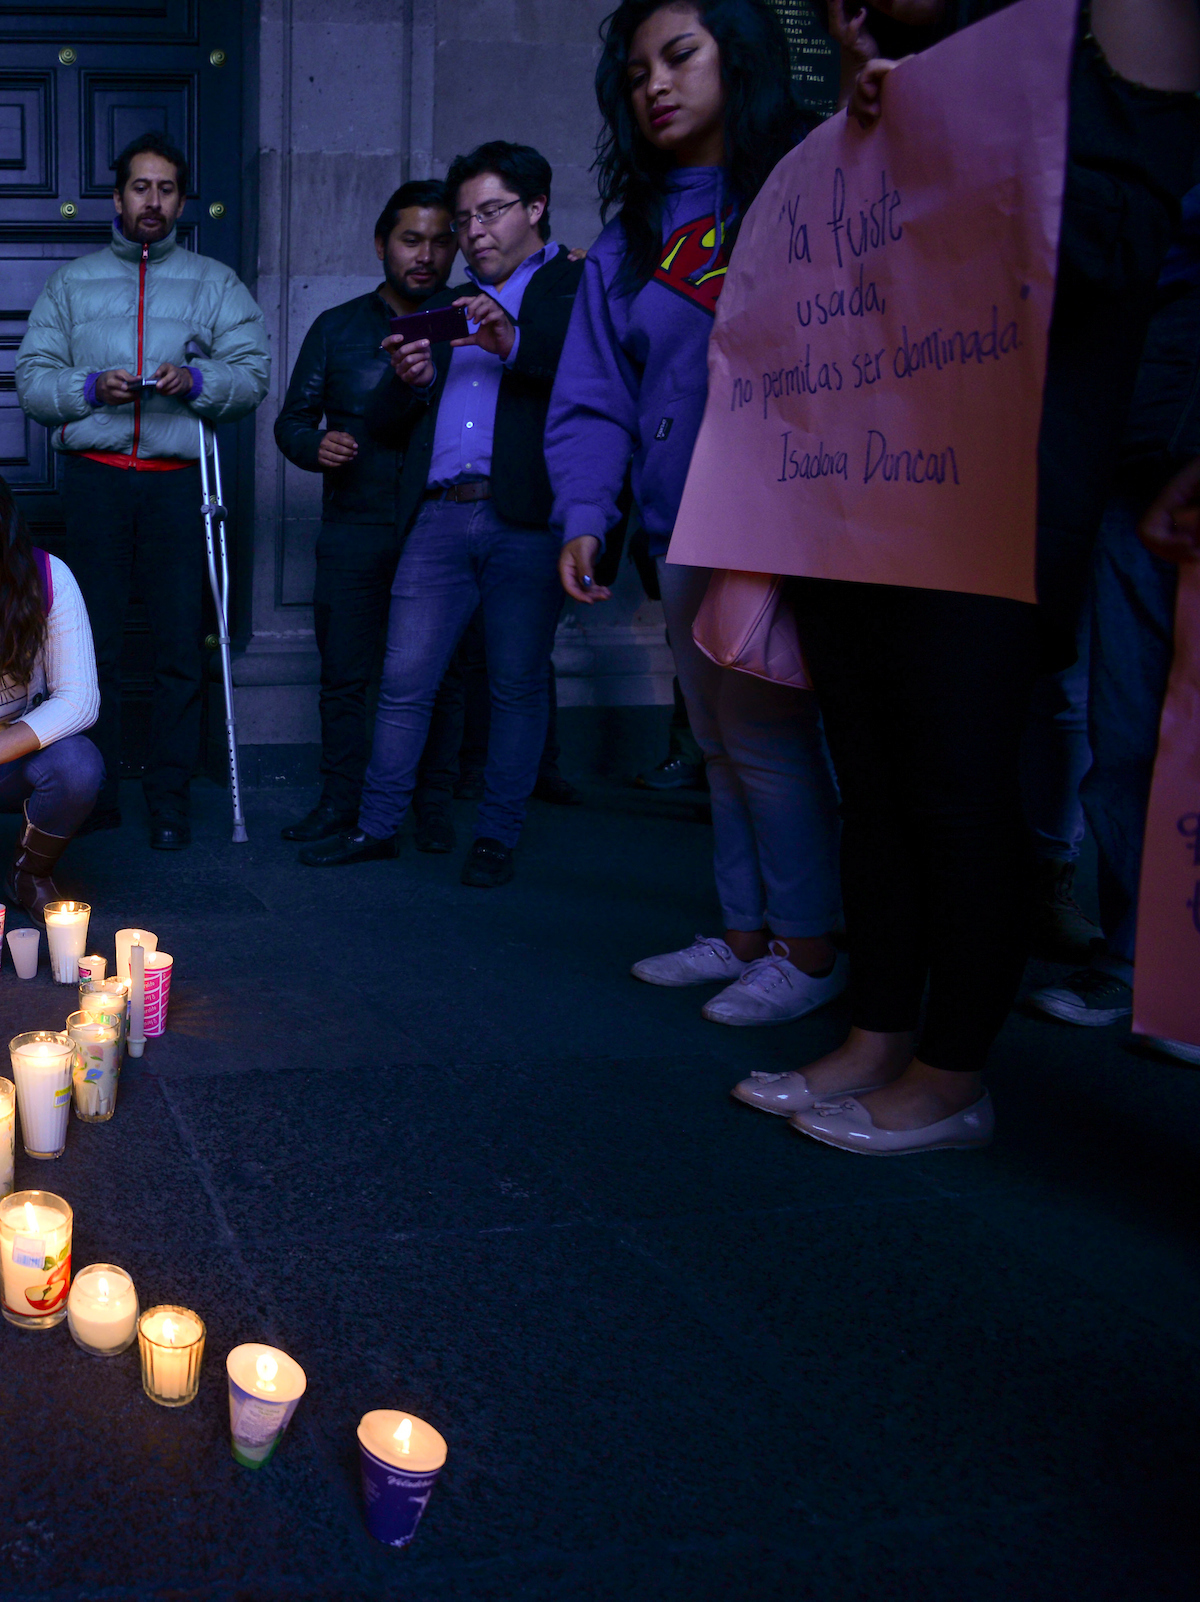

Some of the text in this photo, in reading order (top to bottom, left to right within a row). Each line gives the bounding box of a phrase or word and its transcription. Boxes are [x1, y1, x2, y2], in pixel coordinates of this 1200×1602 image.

[826, 167, 903, 268] fuiste
[730, 376, 753, 412] no
[762, 344, 843, 420] permitas
[853, 349, 885, 389] ser
[777, 429, 960, 485] Isadora Duncan
